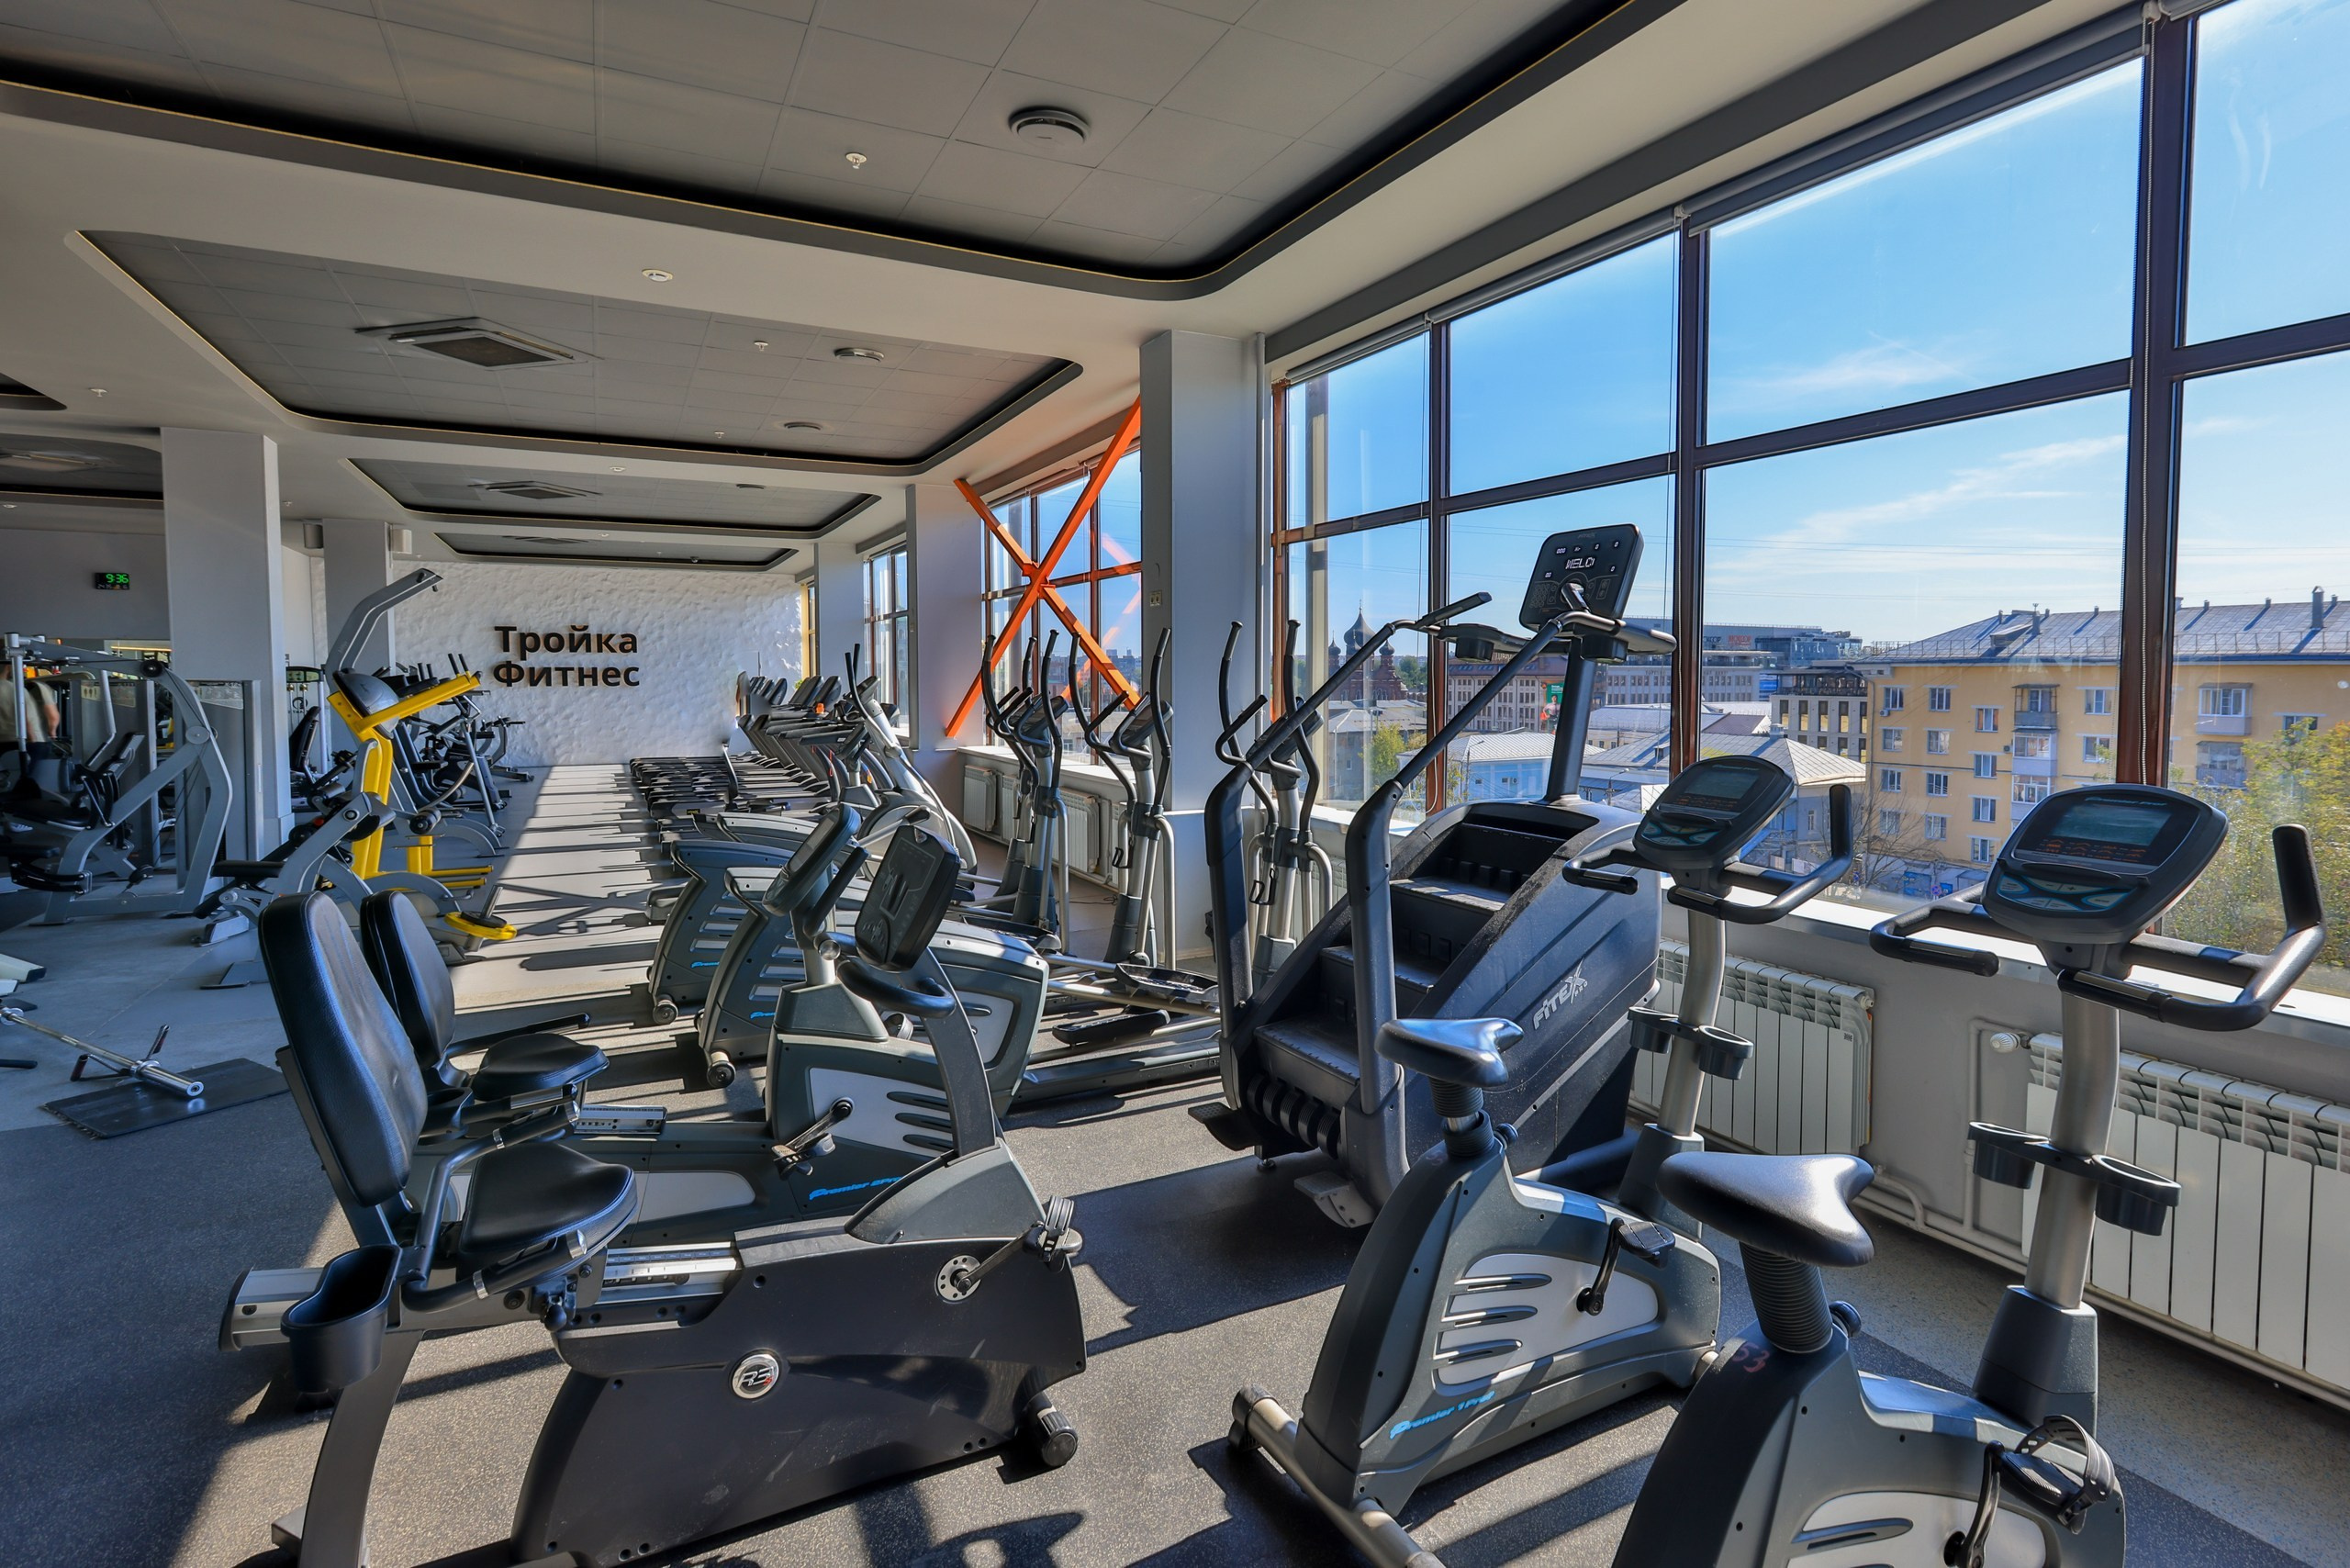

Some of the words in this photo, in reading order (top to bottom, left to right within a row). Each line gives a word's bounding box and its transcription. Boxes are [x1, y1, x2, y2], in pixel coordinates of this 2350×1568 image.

[106, 573, 129, 584] 9:36
[494, 624, 638, 661] Тройка
[493, 660, 640, 688] Фитнес
[809, 1181, 870, 1201] Premier
[1390, 1406, 1456, 1440] Premier
